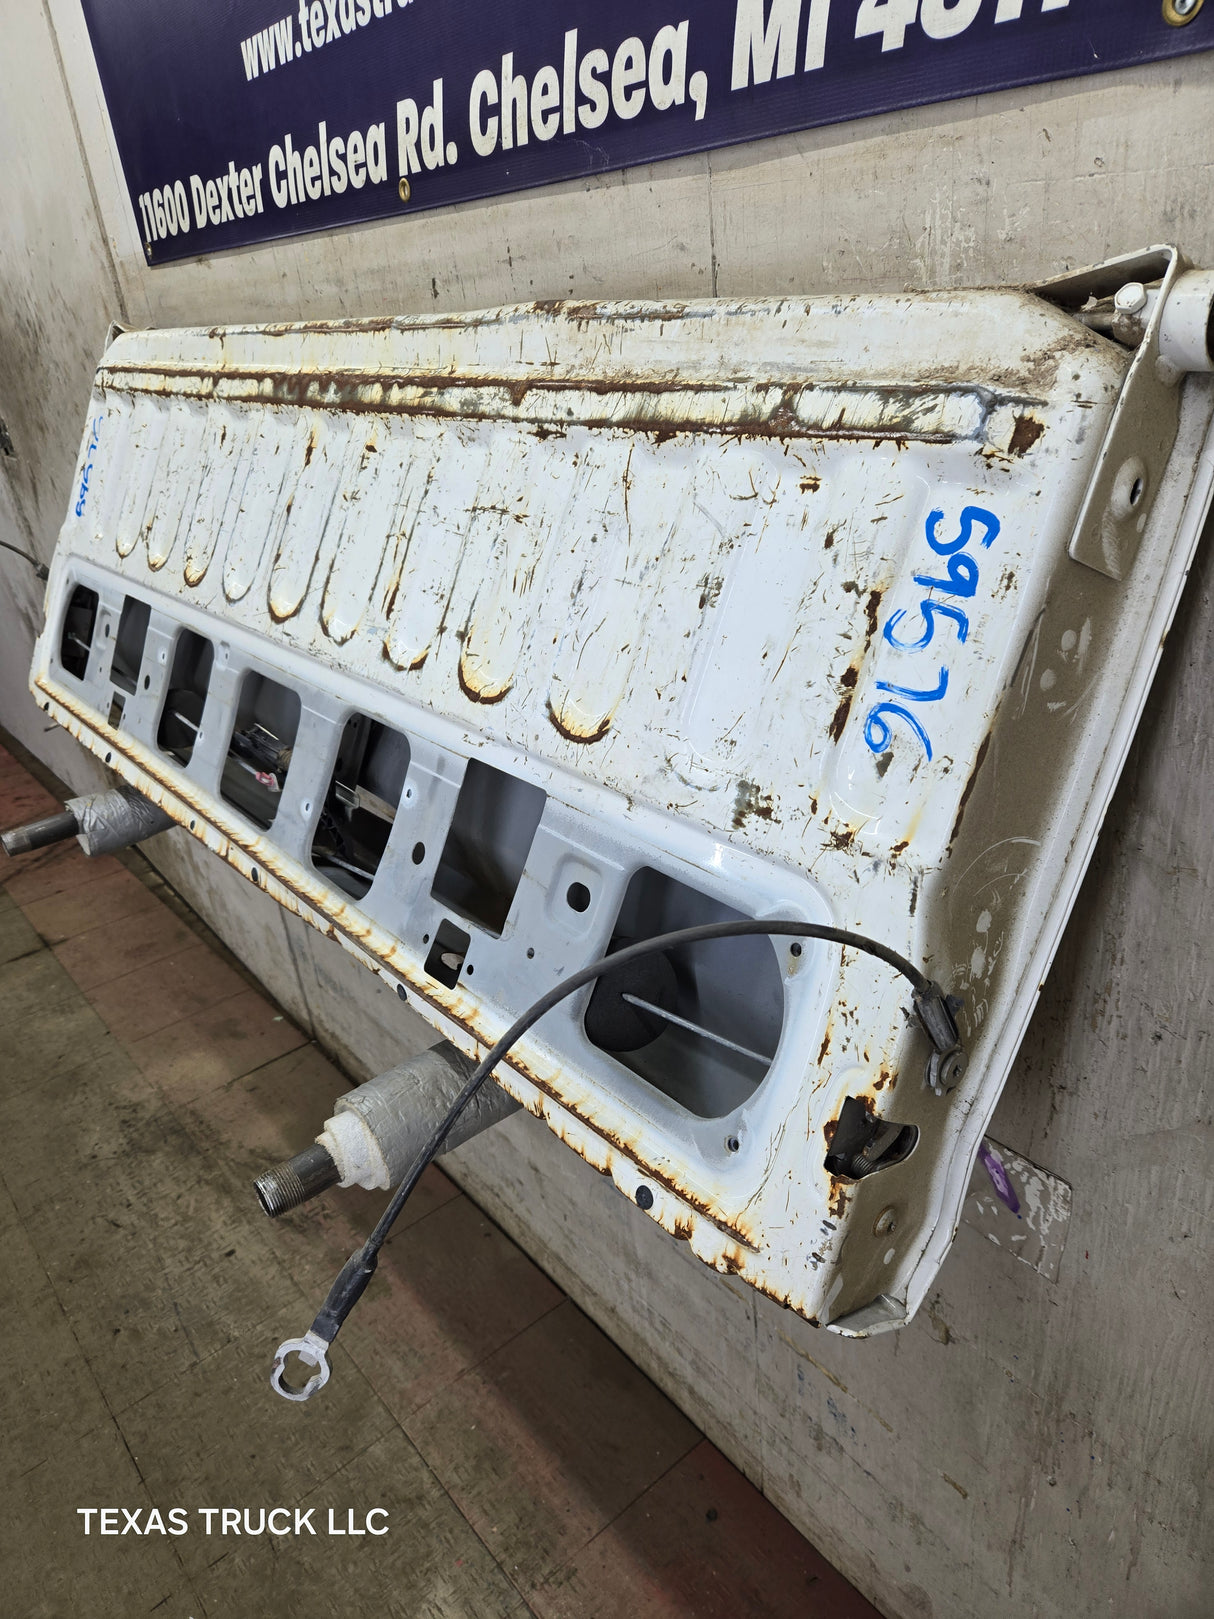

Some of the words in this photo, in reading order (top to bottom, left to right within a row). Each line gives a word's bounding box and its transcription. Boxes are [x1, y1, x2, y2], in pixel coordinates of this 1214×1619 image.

[240, 0, 415, 81] www.texas
[138, 180, 189, 243] 11600
[190, 161, 263, 229] Dexter
[267, 121, 387, 208] Chelsea
[396, 78, 458, 177] Rd.
[470, 20, 708, 158] Chelsea,
